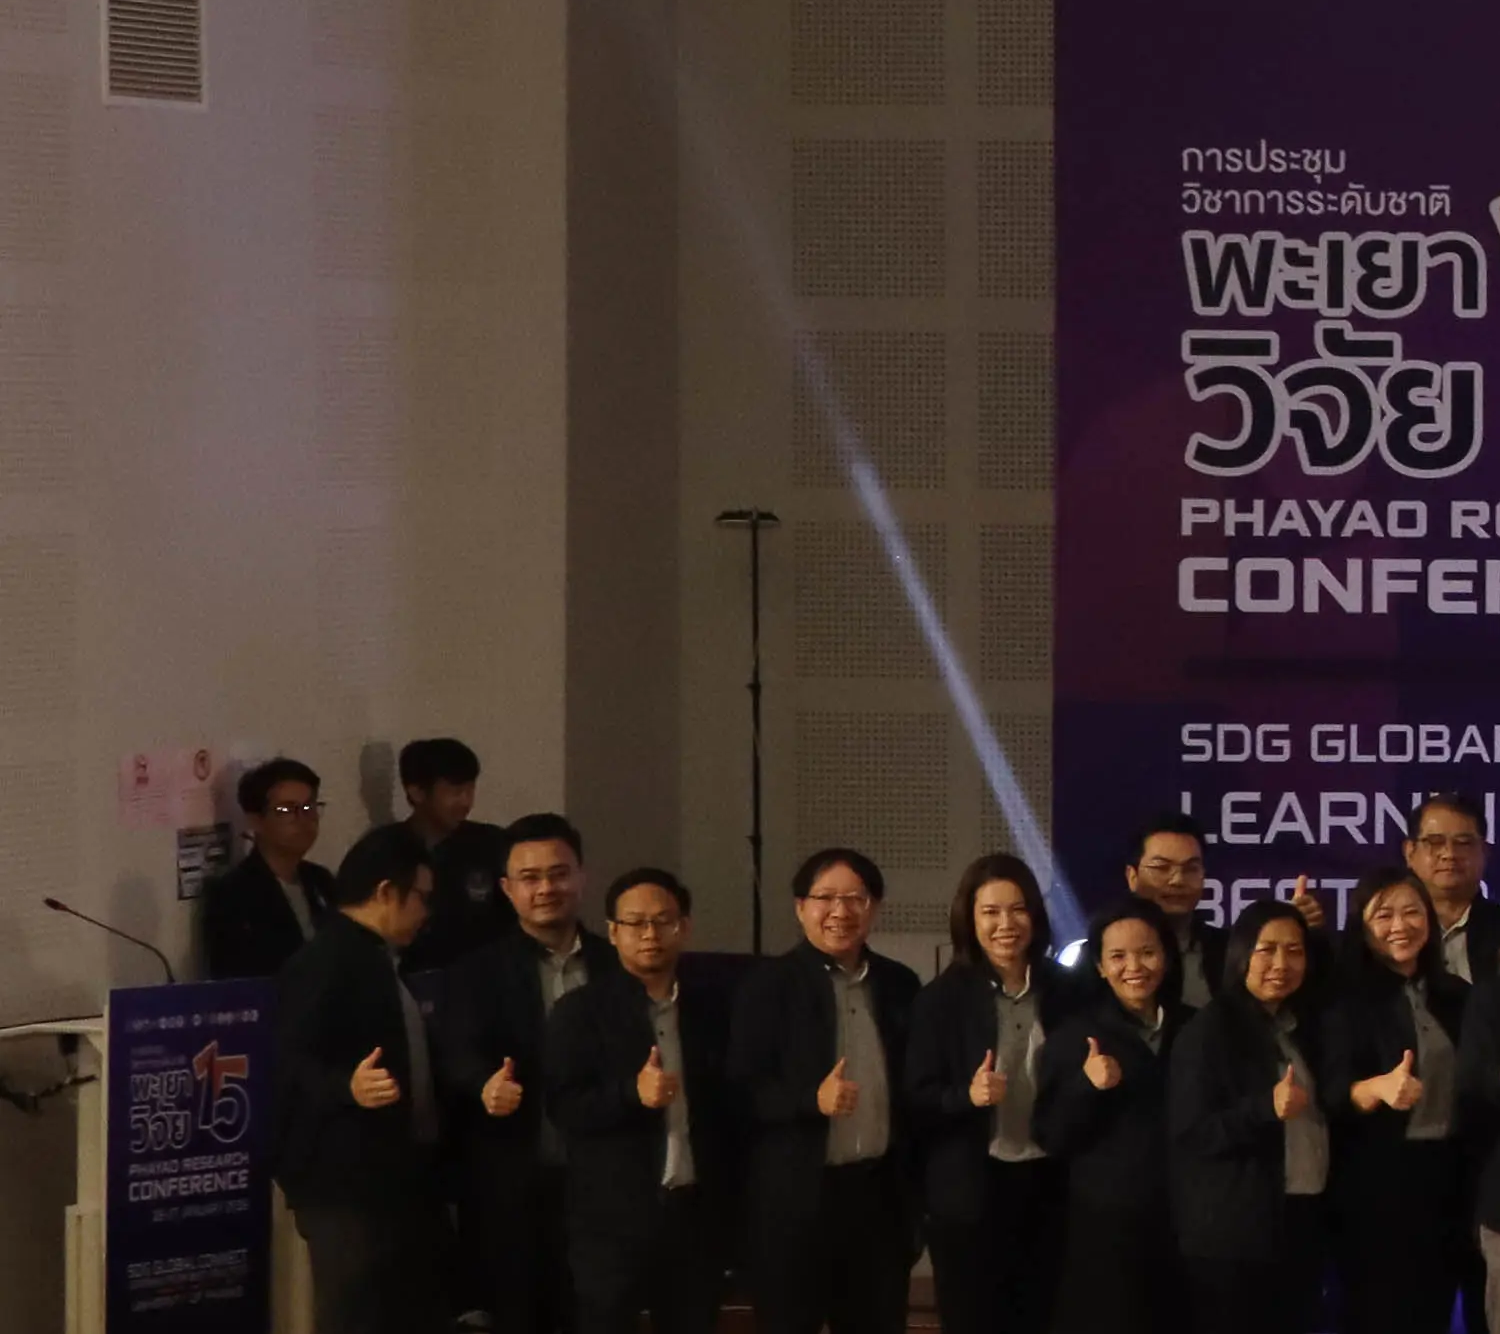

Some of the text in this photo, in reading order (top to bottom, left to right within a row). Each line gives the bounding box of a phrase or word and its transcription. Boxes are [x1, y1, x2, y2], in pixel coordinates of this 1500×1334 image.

[1182, 139, 1346, 184] การประชุม
[1182, 182, 1451, 217] วิชาการระดับชาติ
[1183, 230, 1486, 319] พะเยา
[1182, 320, 1482, 477] วิจัย
[1181, 499, 1428, 539] PHAYAO
[1181, 724, 1291, 763] SDG
[128, 1168, 250, 1203] CONFERENCE
